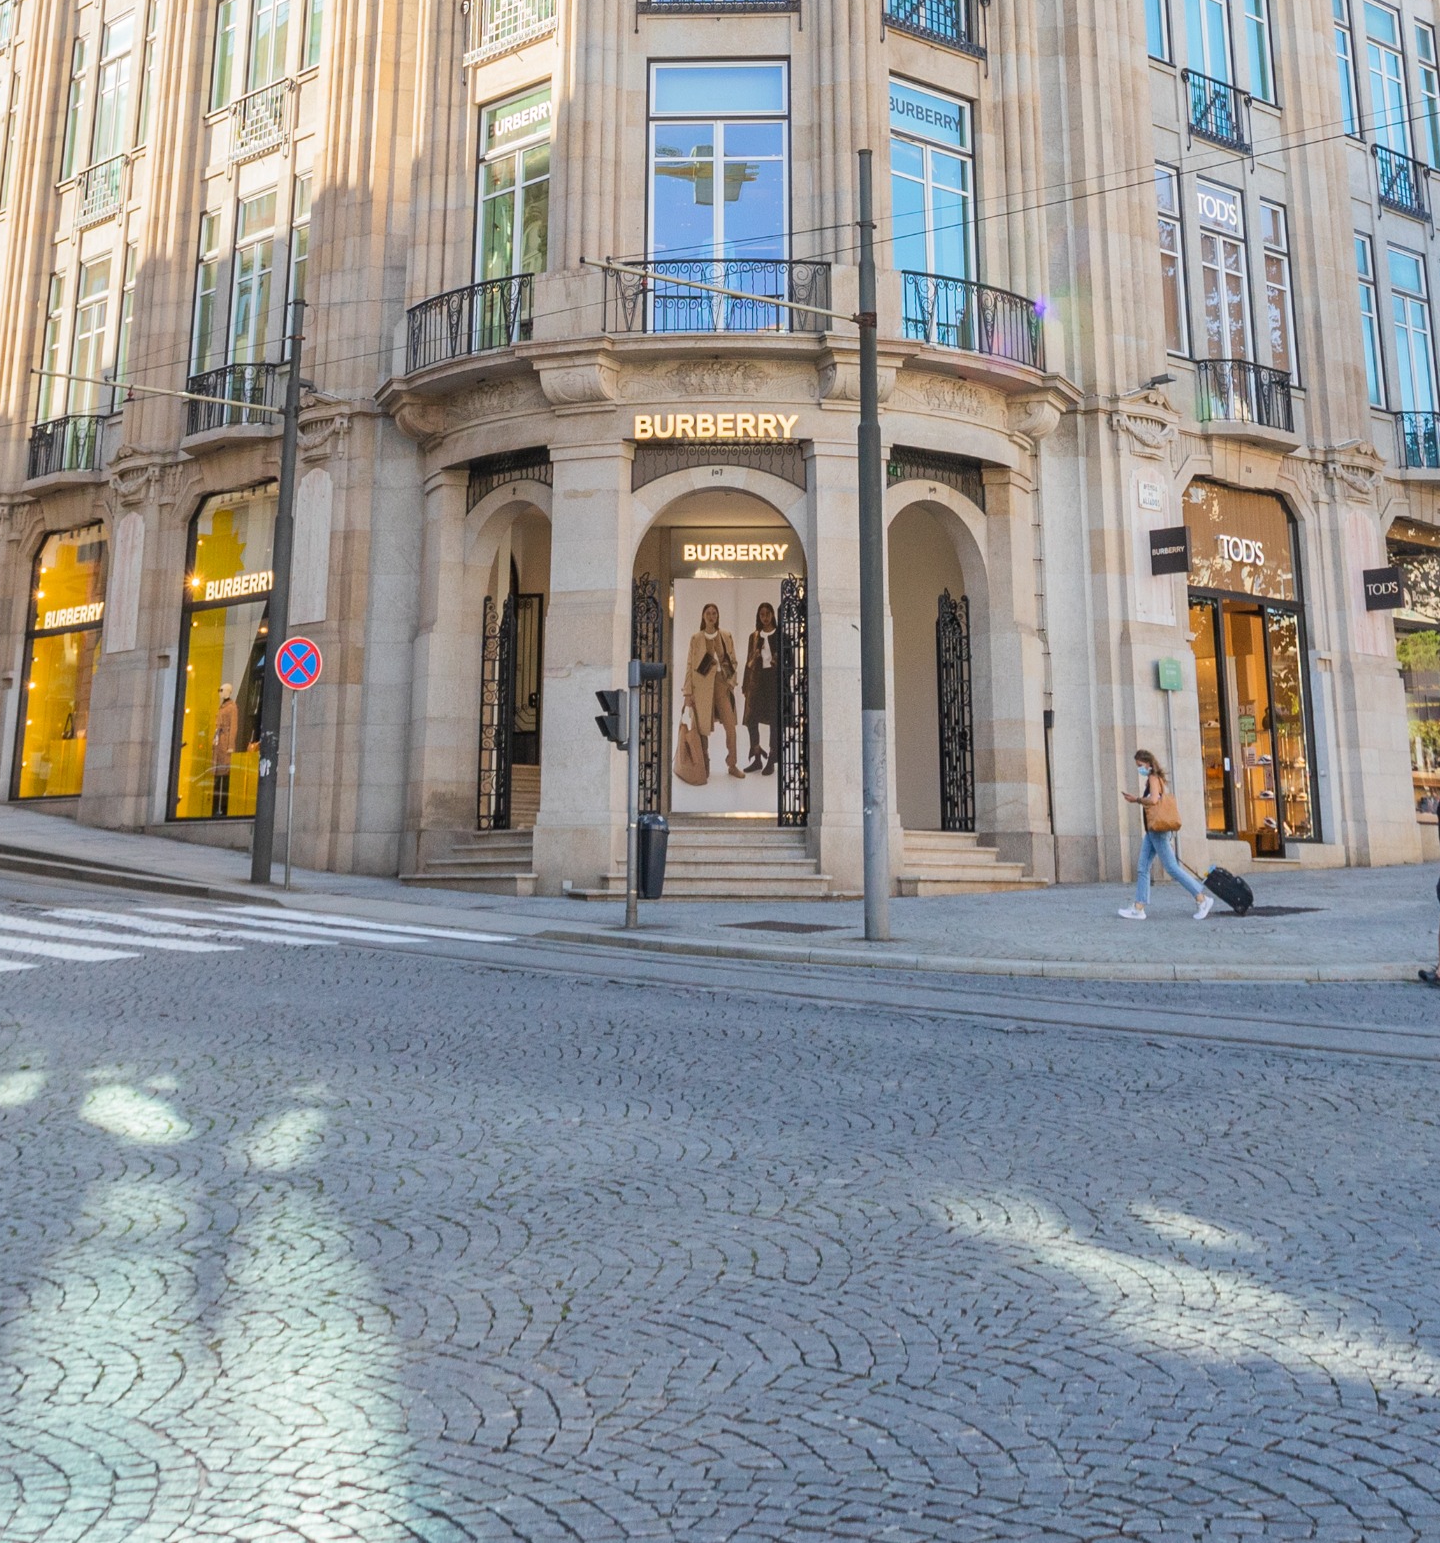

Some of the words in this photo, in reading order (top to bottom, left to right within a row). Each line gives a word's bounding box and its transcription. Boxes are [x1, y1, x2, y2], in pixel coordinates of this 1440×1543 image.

[889, 96, 961, 133] BURBERRY
[1197, 192, 1238, 226] TOD'S
[634, 412, 800, 440] BURBERRY
[683, 543, 789, 561] BURBERRY
[1151, 545, 1186, 557] BURBERRY
[1218, 534, 1265, 567] TOD'S
[1366, 581, 1399, 597] TOD'S
[44, 602, 105, 630] BURBERRY
